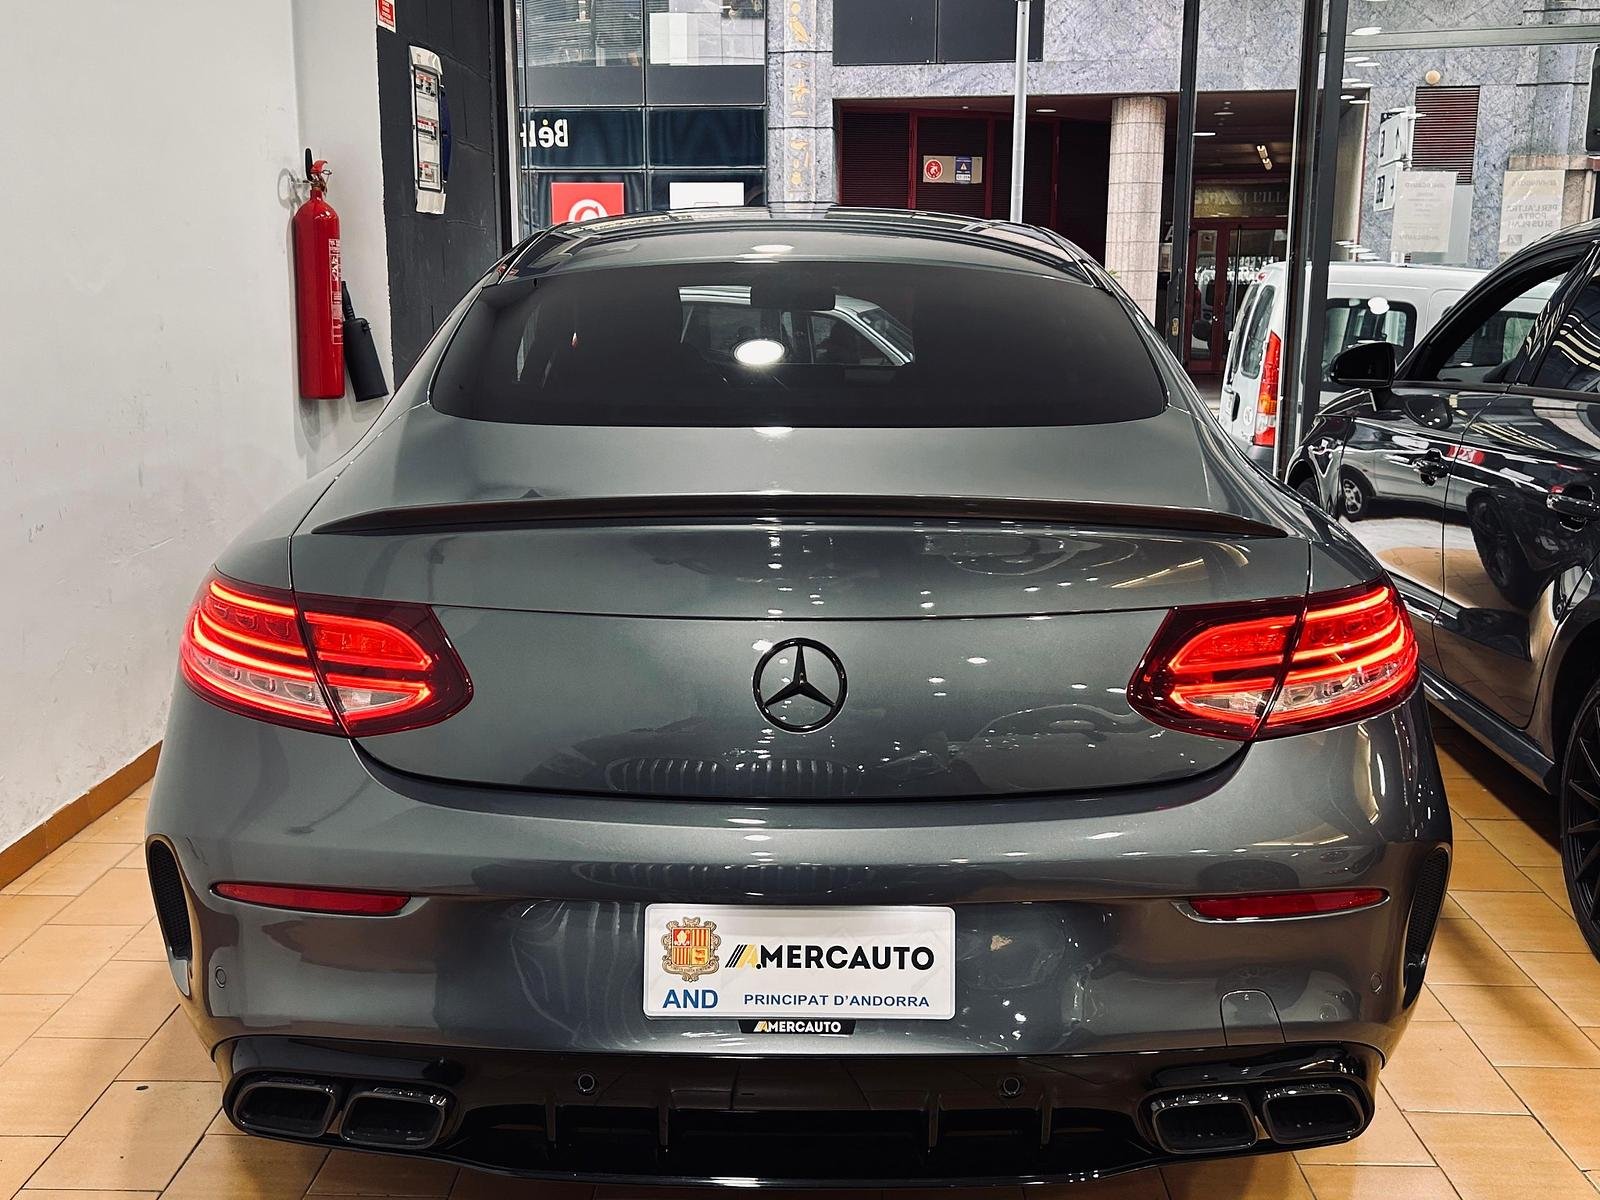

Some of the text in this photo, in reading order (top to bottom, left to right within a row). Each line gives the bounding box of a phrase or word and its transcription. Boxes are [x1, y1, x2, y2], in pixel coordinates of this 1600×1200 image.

[662, 989, 718, 1009] AND
[744, 994, 930, 1007] PRINCIPAT D'ANDORRA
